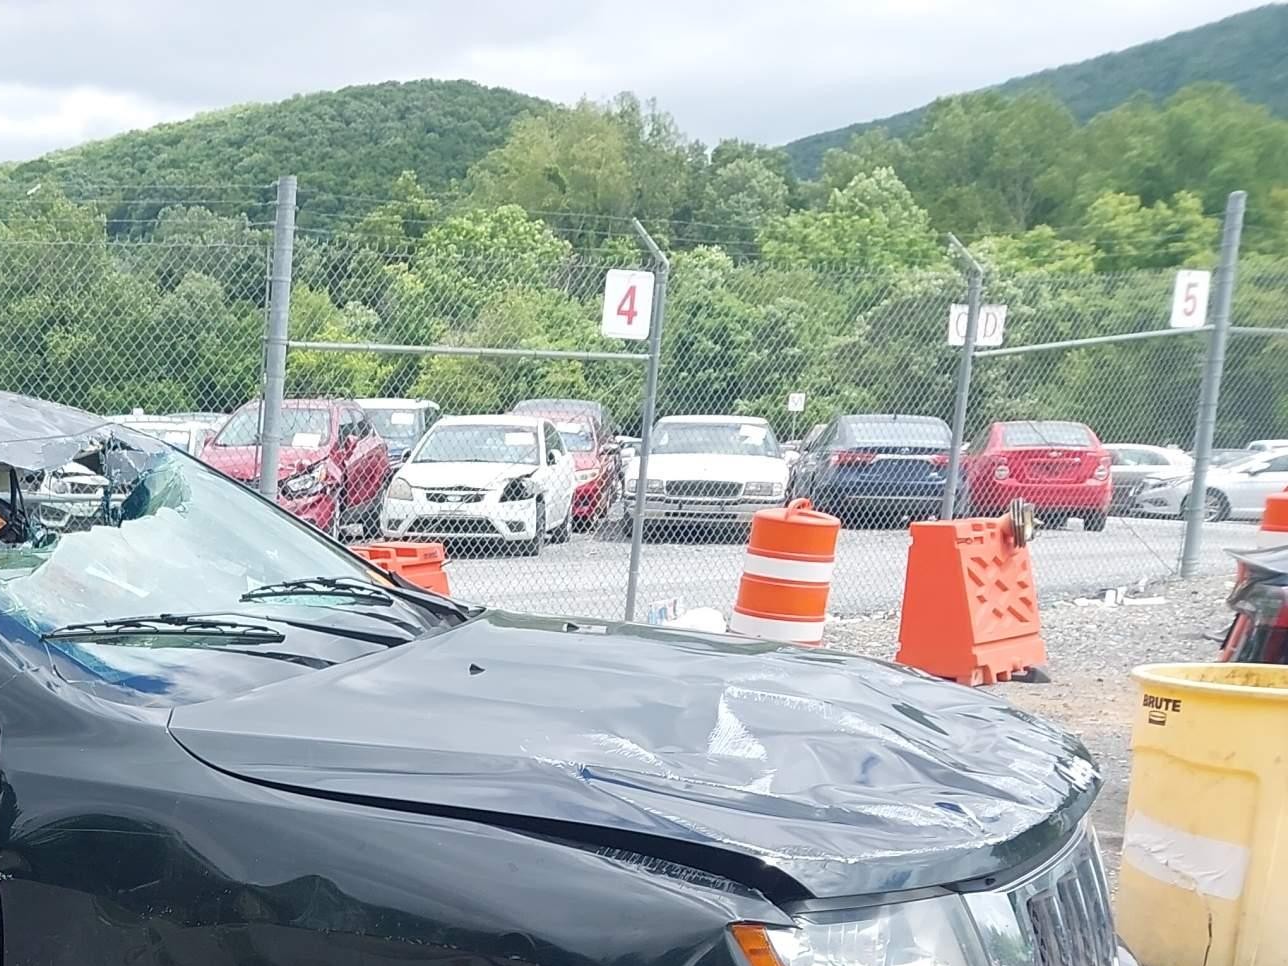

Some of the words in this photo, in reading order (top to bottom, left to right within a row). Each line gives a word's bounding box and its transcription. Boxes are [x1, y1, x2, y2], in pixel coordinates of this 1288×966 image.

[616, 285, 638, 325] 4
[1183, 282, 1199, 317] 5
[1143, 694, 1182, 712] BRUTE
